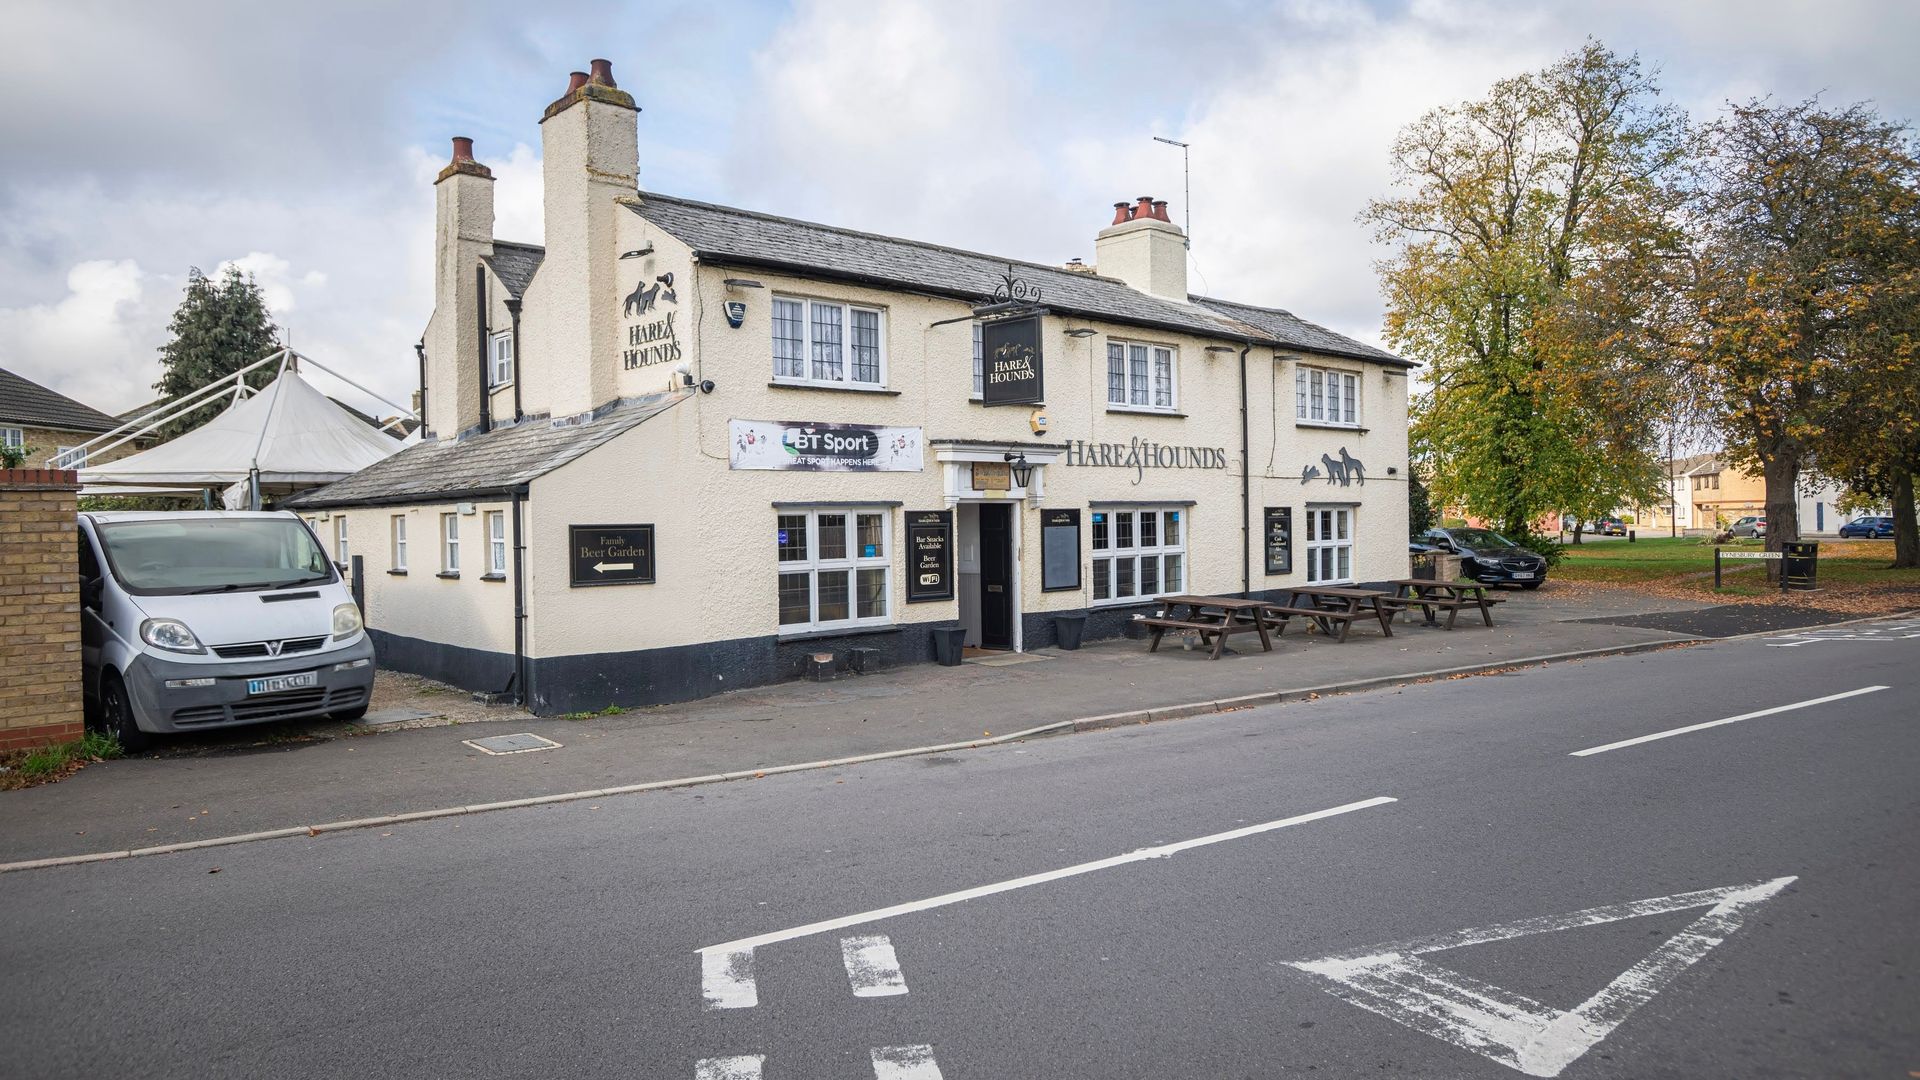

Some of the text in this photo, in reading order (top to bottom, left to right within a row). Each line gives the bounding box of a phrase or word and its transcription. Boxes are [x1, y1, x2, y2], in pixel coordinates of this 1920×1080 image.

[624, 341, 682, 371] HOUNDS
[990, 369, 1035, 384] HOUNDS
[795, 432, 869, 454] BT Sport
[807, 457, 829, 466] SPORT
[831, 458, 862, 466] HAPPENS
[1142, 443, 1227, 469] HOUNDS
[600, 536, 626, 546] Family
[581, 546, 645, 558] Beer Garden
